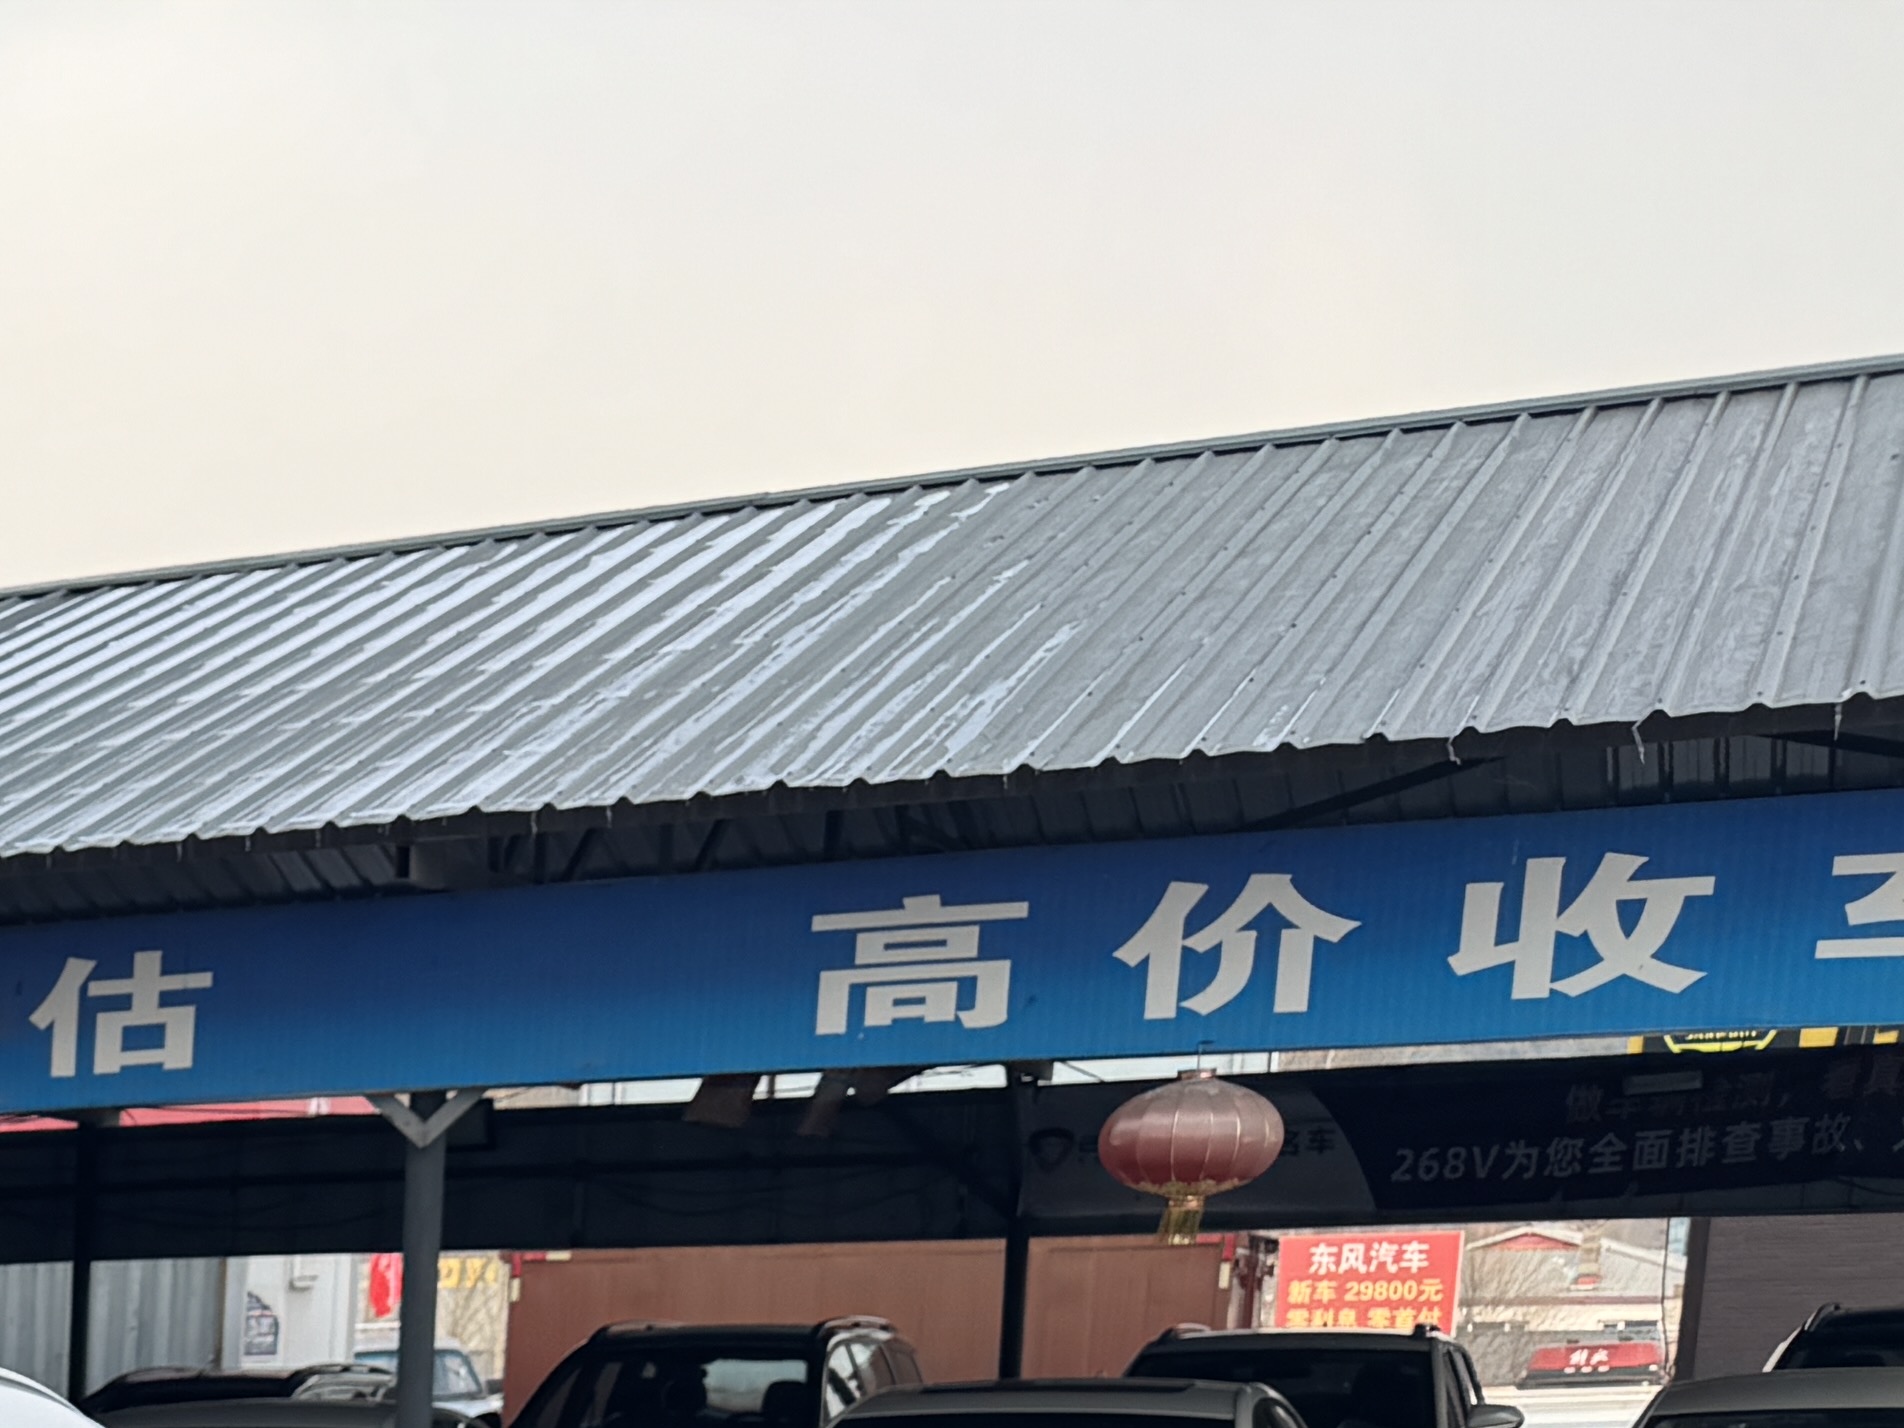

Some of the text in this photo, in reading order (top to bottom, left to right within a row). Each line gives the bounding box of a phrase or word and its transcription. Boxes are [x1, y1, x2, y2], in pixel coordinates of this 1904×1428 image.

[1308, 1241, 1430, 1275] 东风汽车
[1288, 1277, 1444, 1304] 新车 29800元
